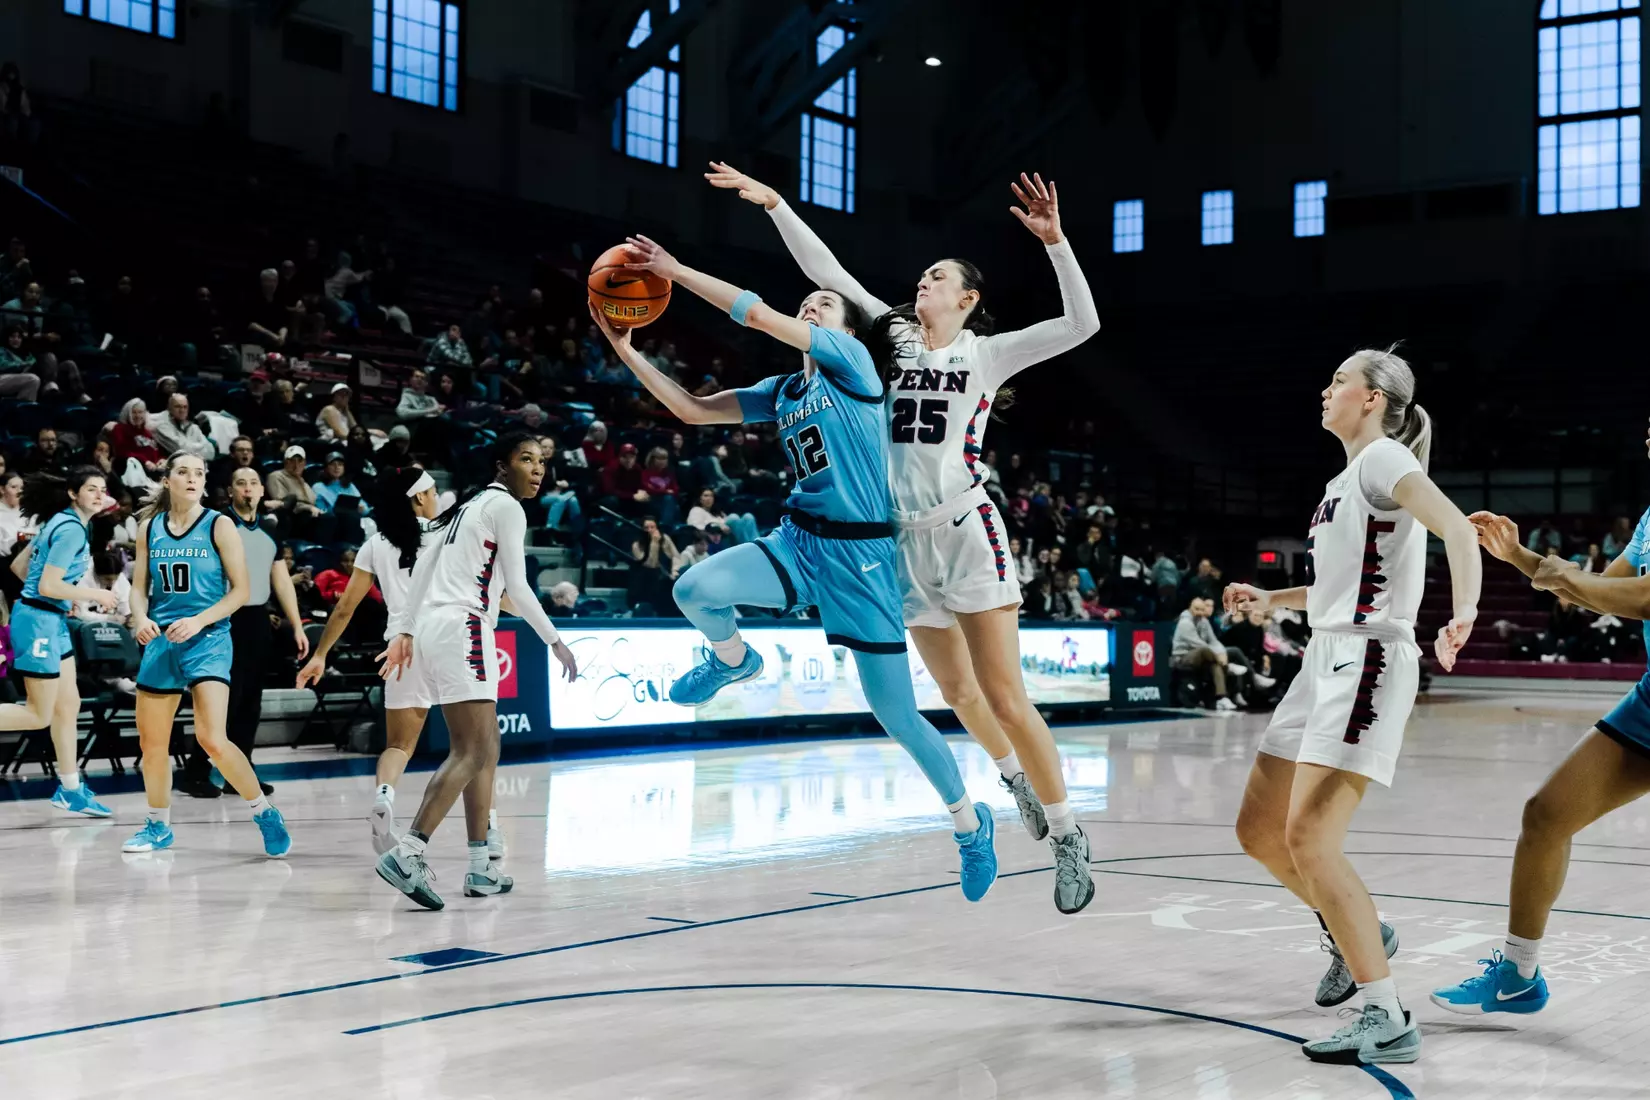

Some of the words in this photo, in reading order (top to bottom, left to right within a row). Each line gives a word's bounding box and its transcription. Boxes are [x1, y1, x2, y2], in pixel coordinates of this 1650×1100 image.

[603, 301, 649, 317] ELITE
[884, 368, 970, 394] PENN
[777, 395, 833, 431] LUMBIA
[892, 398, 949, 445] 25
[785, 424, 832, 482] 12
[150, 548, 208, 558] COLUMBIA
[158, 562, 191, 594] 10
[32, 638, 49, 658] C
[1127, 686, 1161, 701] TOYOTA
[497, 713, 532, 734] OTA
